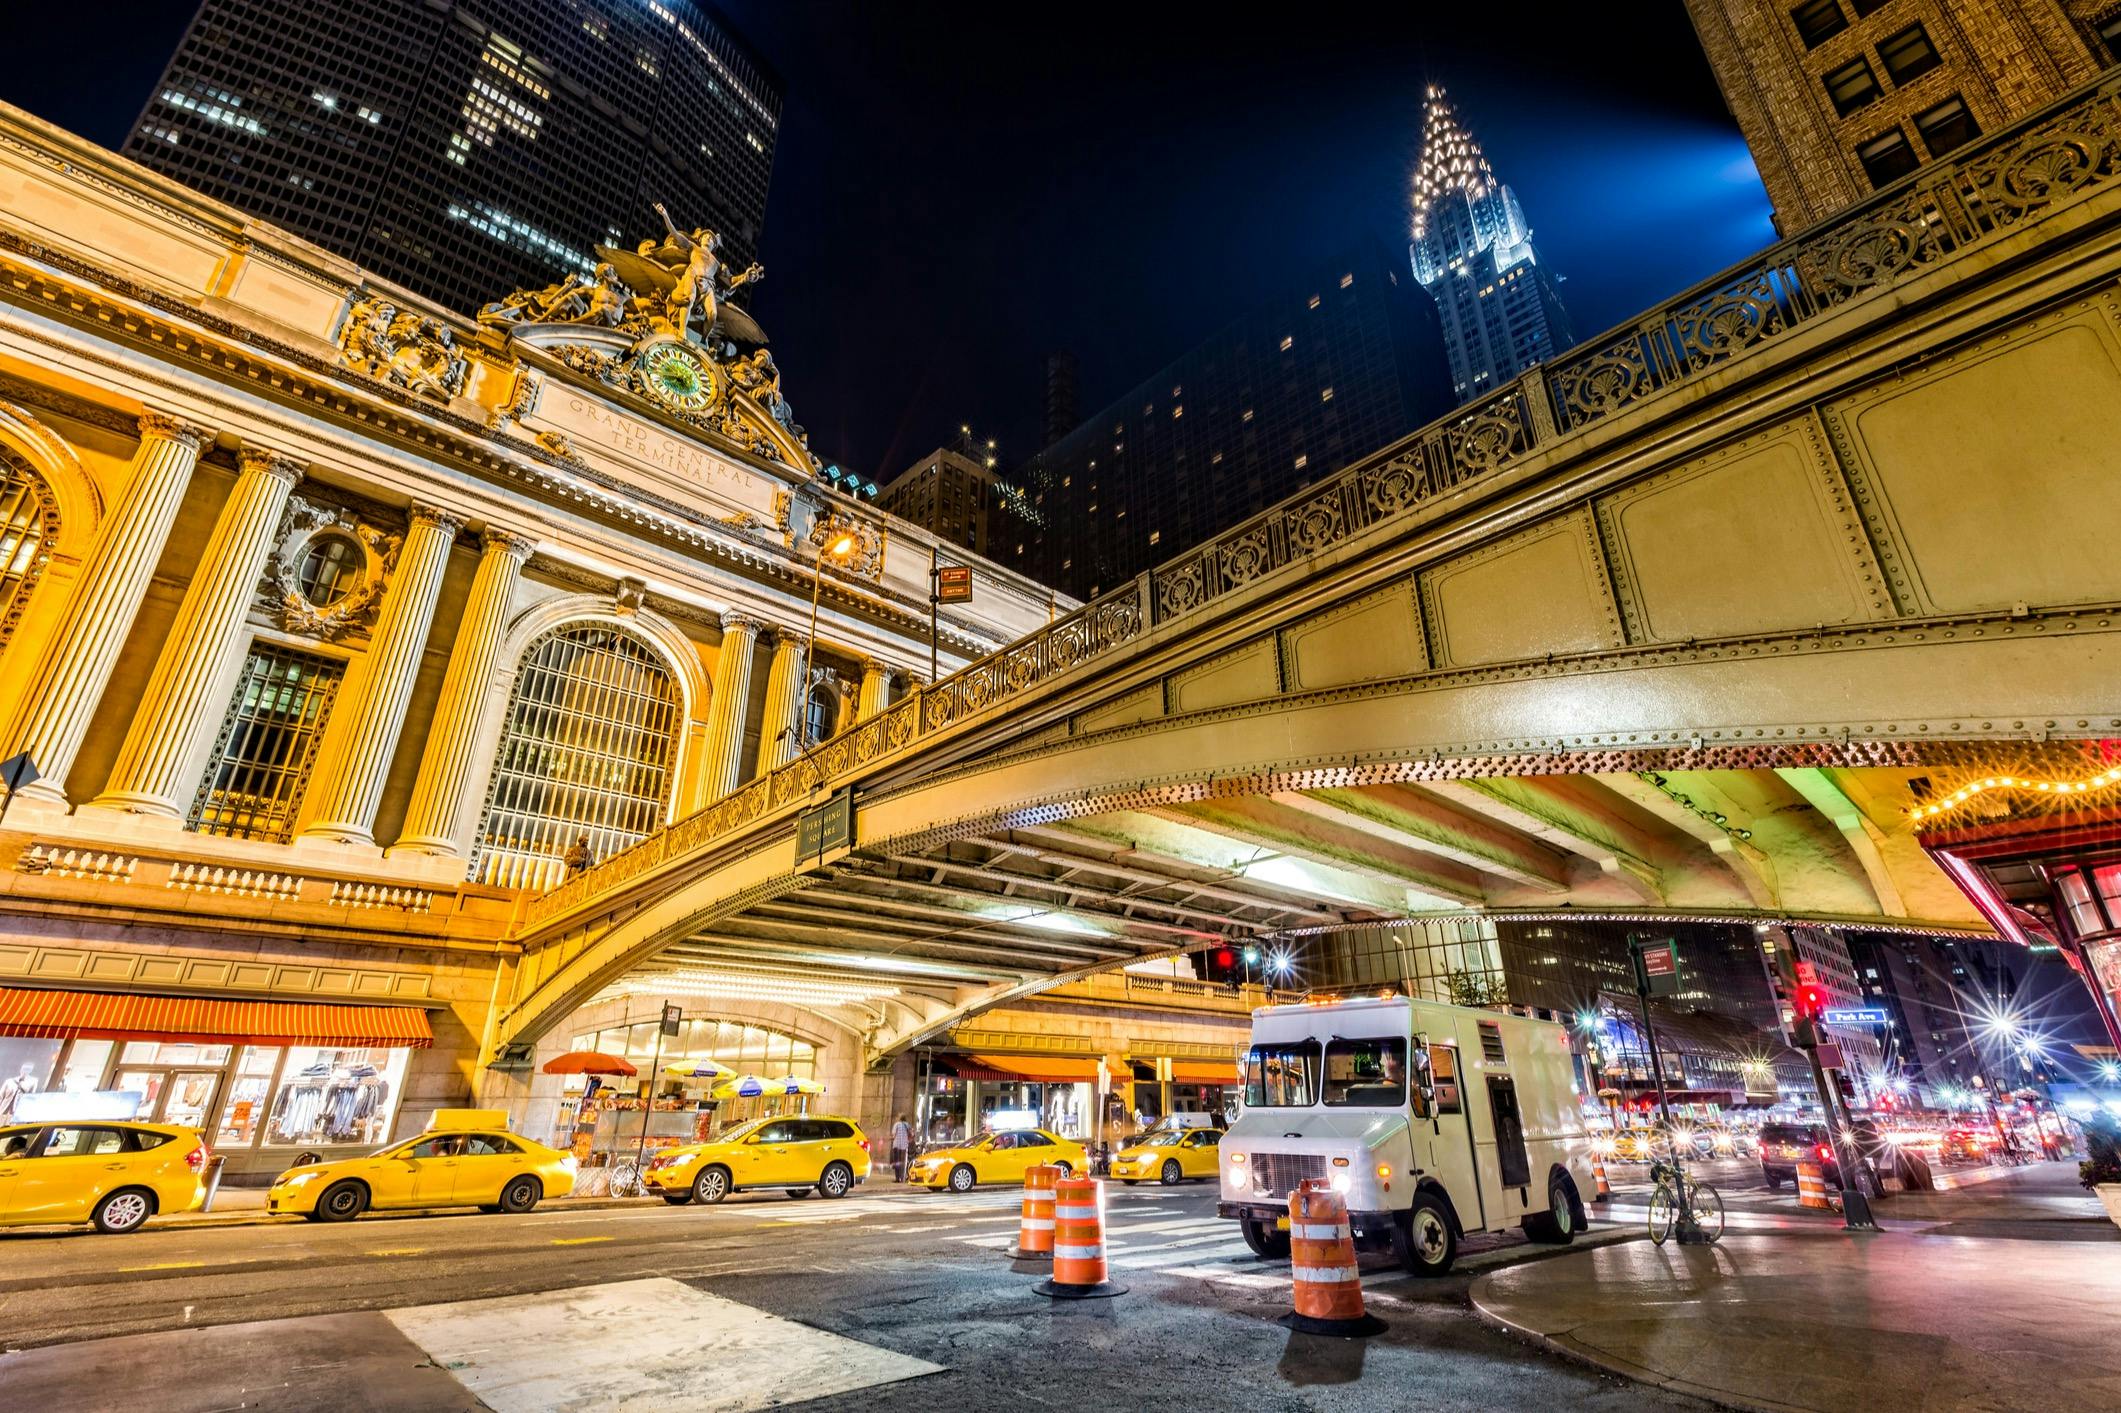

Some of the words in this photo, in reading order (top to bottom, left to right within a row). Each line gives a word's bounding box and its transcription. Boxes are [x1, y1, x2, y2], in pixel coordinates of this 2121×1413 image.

[569, 400, 647, 441] GRAND
[662, 440, 753, 488] CENTRAL
[611, 430, 715, 486] TERMINAL
[806, 809, 841, 832] PERSHING
[809, 825, 836, 843] SQUARE
[1835, 1013, 1857, 1021] Park
[1858, 1012, 1876, 1021] Ave
